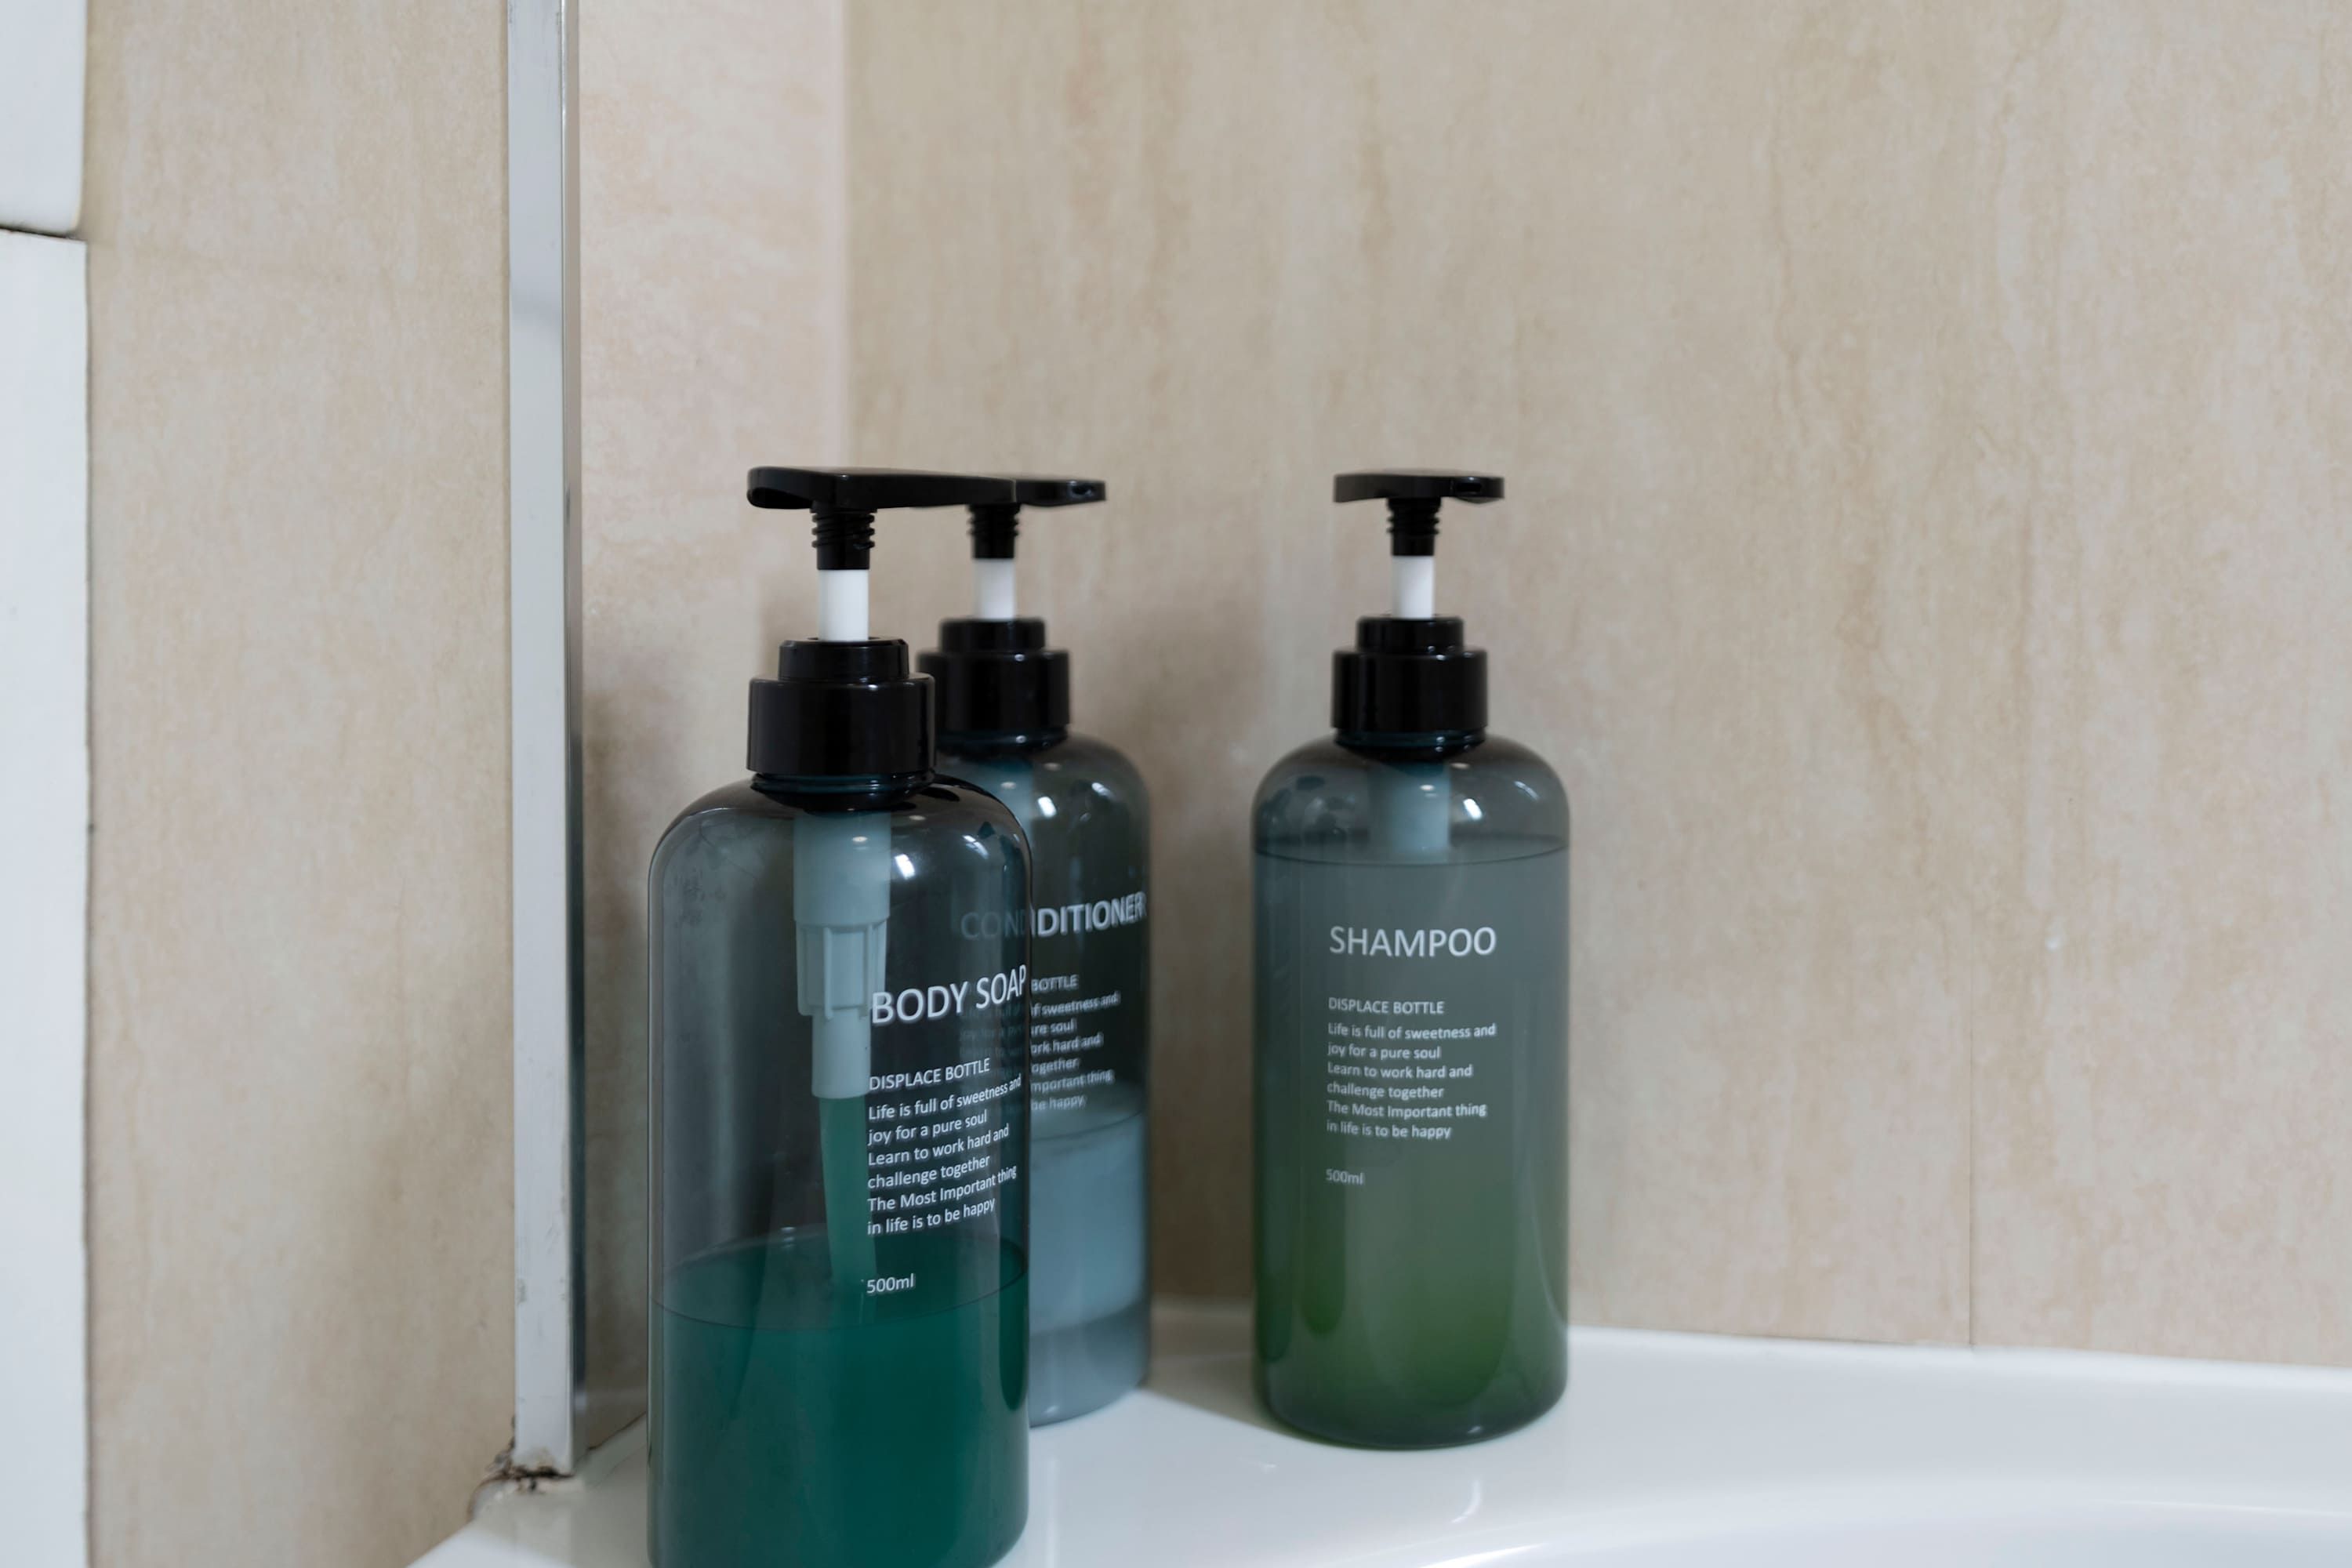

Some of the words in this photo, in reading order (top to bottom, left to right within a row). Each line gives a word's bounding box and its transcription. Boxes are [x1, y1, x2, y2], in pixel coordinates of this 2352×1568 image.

[1330, 926, 1496, 957] SHAMPOO
[873, 982, 968, 1023] BODY
[976, 964, 1026, 1008] SOAP
[1041, 996, 1098, 1015] sweetness
[1101, 991, 1120, 1006] and
[1328, 997, 1388, 1013] DISPLACE
[1393, 1001, 1445, 1014] BOTTLE
[1050, 1018, 1076, 1033] soul
[1328, 1023, 1348, 1035] Life
[1352, 1025, 1360, 1037] is
[1365, 1025, 1384, 1038] full
[1388, 1026, 1402, 1039] of
[1405, 1026, 1471, 1040] sweetness
[1474, 1023, 1496, 1037] and
[1031, 1040, 1051, 1053] ork
[1053, 1037, 1080, 1051] hard
[1080, 1033, 1102, 1047] and
[1327, 1043, 1345, 1056] joy
[1348, 1044, 1366, 1056] for
[1370, 1048, 1376, 1058] a
[1381, 1048, 1410, 1060] pure
[1414, 1047, 1441, 1059] soul
[869, 1069, 941, 1091] DISPLACE
[946, 1058, 990, 1080] BOTTLE
[1031, 1057, 1080, 1074] ogether
[1327, 1062, 1360, 1076] Learn
[1364, 1065, 1377, 1077] to
[1381, 1066, 1413, 1079] work
[1416, 1065, 1446, 1078] hard
[1449, 1064, 1473, 1077] and
[1031, 1073, 1085, 1093] mportant
[1087, 1069, 1114, 1084] thing
[869, 1105, 895, 1120] Life
[899, 1104, 910, 1116] is
[915, 1098, 936, 1114] full
[940, 1096, 953, 1110] of
[957, 1082, 1007, 1107] sweetness
[1009, 1073, 1022, 1092] and
[1327, 1082, 1385, 1099] challenge
[1388, 1086, 1444, 1101] together
[1050, 1094, 1085, 1111] happy
[1327, 1100, 1348, 1113] The
[1352, 1104, 1384, 1116] Most
[1388, 1106, 1451, 1120] Important
[1455, 1103, 1486, 1116] thing
[868, 1130, 891, 1145] joy
[895, 1125, 916, 1140] for
[920, 1126, 928, 1136] a
[933, 1120, 961, 1137] pure
[965, 1109, 987, 1127] soul
[1327, 1120, 1337, 1131] in
[1341, 1121, 1359, 1134] life
[1362, 1123, 1371, 1135] is
[1375, 1126, 1388, 1137] to
[1392, 1125, 1408, 1137] be
[1411, 1125, 1451, 1139] happy
[868, 1152, 909, 1166] Learn
[914, 1148, 928, 1160] to
[933, 1139, 964, 1156] work
[967, 1131, 990, 1149] hard
[993, 1123, 1009, 1142] and
[868, 1169, 937, 1189] challenge
[941, 1156, 989, 1178] together
[1326, 1169, 1364, 1185] 500ml
[868, 1198, 895, 1211] The
[901, 1191, 936, 1208] Most
[940, 1175, 996, 1201] Important
[998, 1165, 1017, 1184] thing
[868, 1221, 881, 1235] in
[886, 1218, 908, 1232] life
[913, 1215, 923, 1229] is
[927, 1214, 940, 1226] to
[945, 1209, 960, 1223] be
[964, 1198, 995, 1218] happy
[866, 1273, 915, 1294] 500ml
